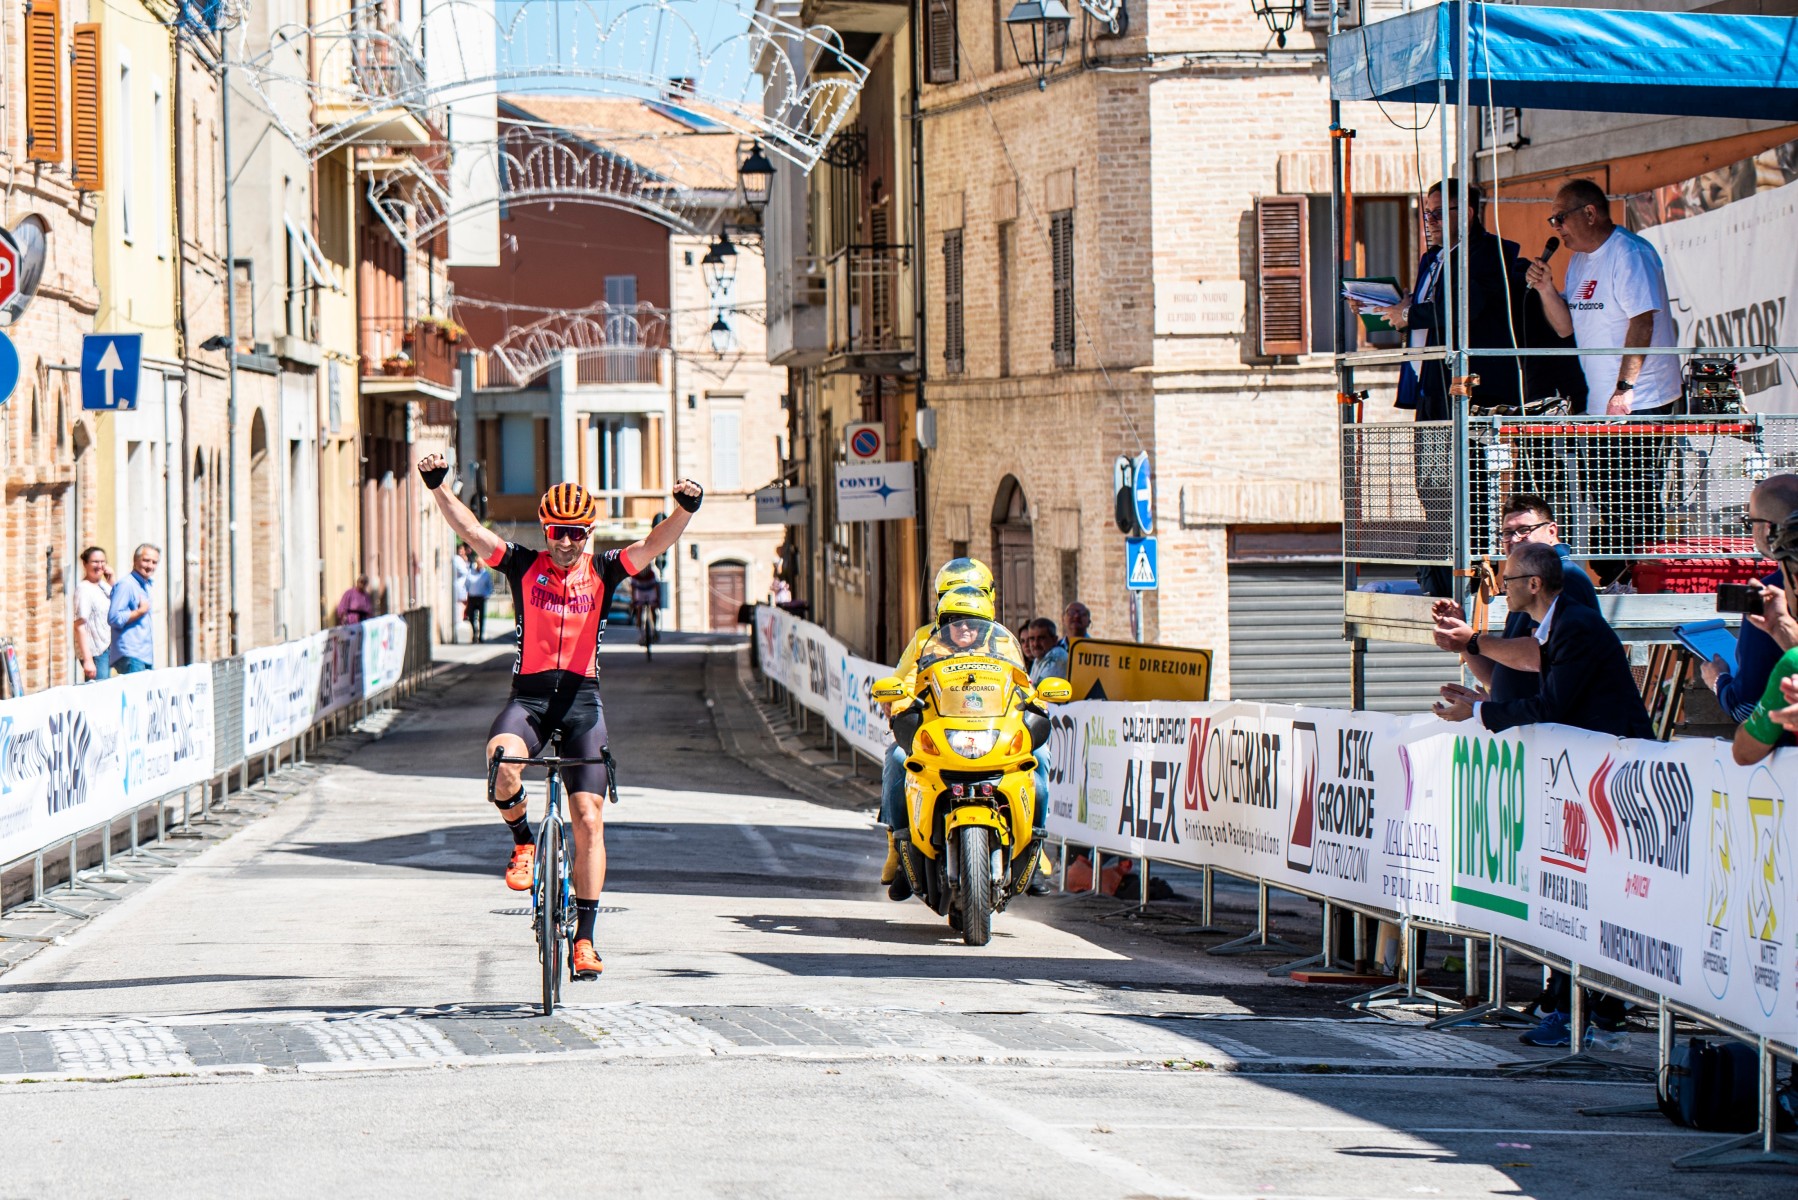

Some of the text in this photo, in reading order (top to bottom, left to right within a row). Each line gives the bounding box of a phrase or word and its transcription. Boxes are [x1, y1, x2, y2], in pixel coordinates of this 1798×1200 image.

[1579, 301, 1604, 310] balance
[839, 476, 881, 489] CONTI
[957, 663, 1002, 672] CAPODARCO
[1078, 652, 1202, 676] TUTTE LE DIREZIONI
[1338, 728, 1375, 782] ISTAL
[1117, 759, 1182, 844] ALEX
[1317, 781, 1375, 839] GRONDE
[1184, 818, 1214, 847] Printing
[1213, 821, 1228, 843] and
[1228, 822, 1254, 855] Packaging
[1382, 818, 1440, 862] MALAIGIA
[1315, 839, 1370, 884] COSTRUZIONI
[1382, 874, 1440, 905] PELLAMI
[1539, 870, 1589, 911] IMPRESA EDILE
[1645, 935, 1683, 986] INDUSTRIALI
